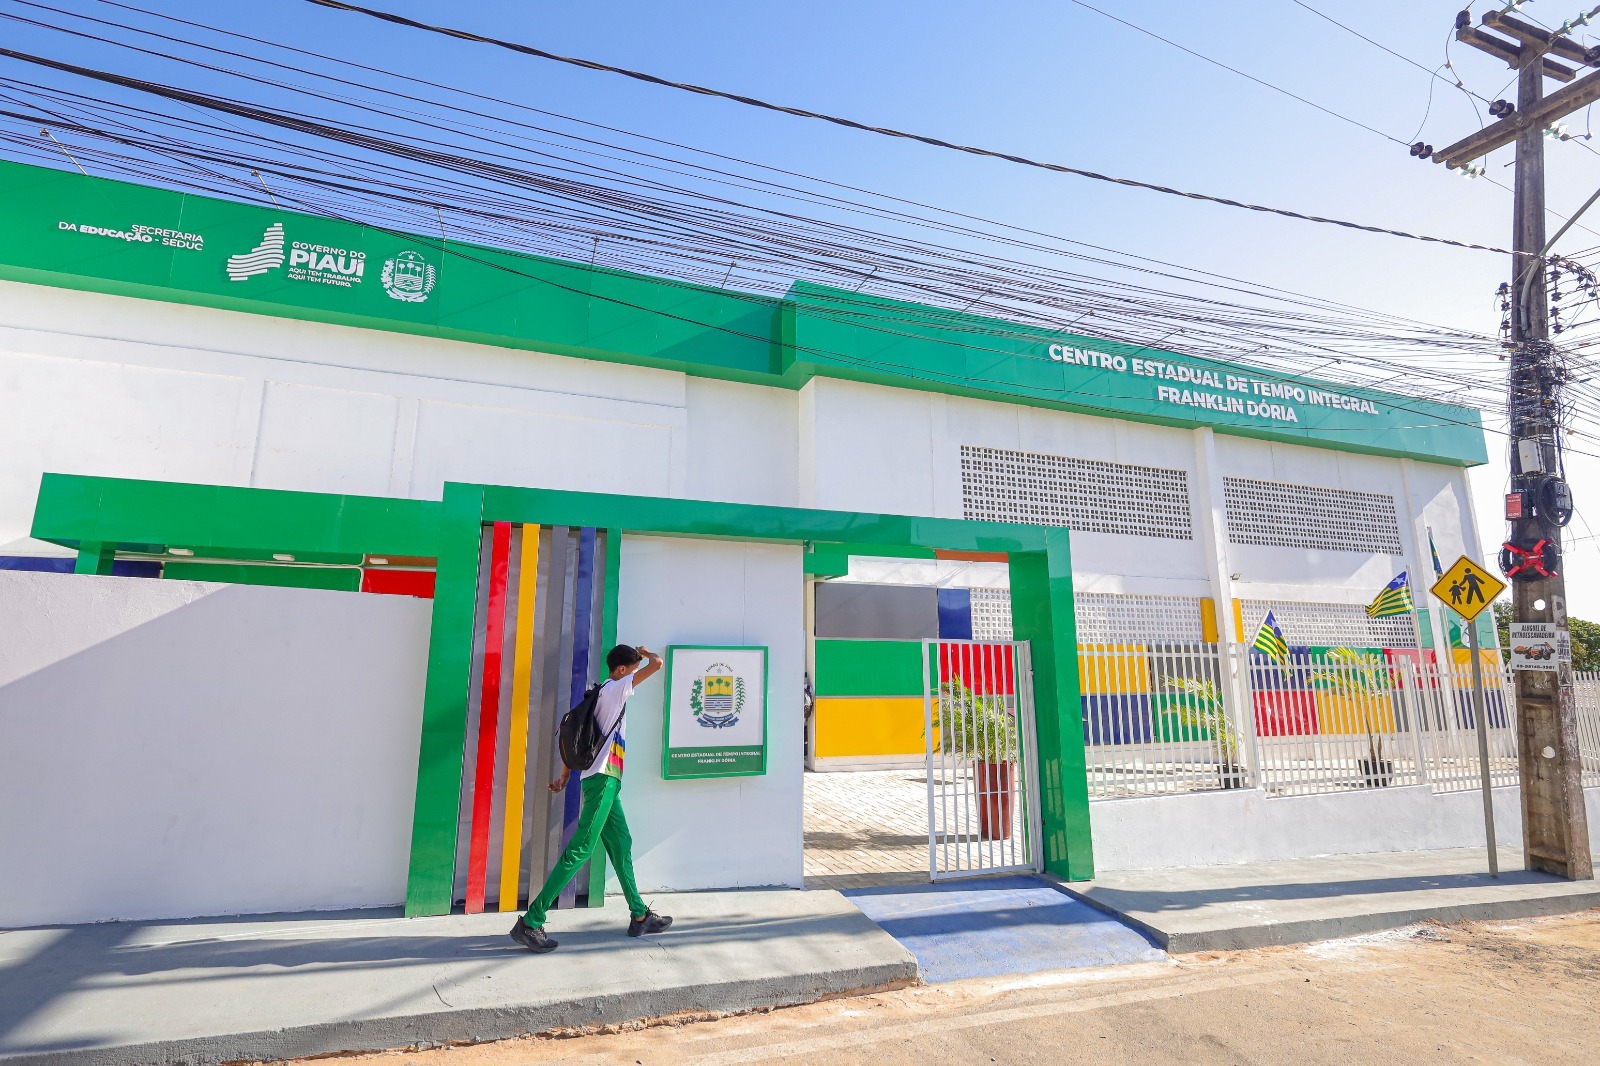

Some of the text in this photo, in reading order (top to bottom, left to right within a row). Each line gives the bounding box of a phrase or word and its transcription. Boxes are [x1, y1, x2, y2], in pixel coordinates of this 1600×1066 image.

[58, 221, 77, 231] DA
[79, 224, 152, 243] EDUCAÇÃO
[161, 237, 204, 251] SEDUC
[131, 224, 204, 243] SECRETARIA
[292, 241, 366, 259] GOVERNO DO
[287, 273, 306, 281] AQUI
[307, 275, 321, 283] TEM
[288, 267, 307, 275] AQUI
[308, 269, 322, 277] TEM
[1048, 343, 1379, 415] CENTRO ESTADUAL DE TEMPO INTEGRAL
[1157, 385, 1299, 423] FRANKLIN DÓRIA
